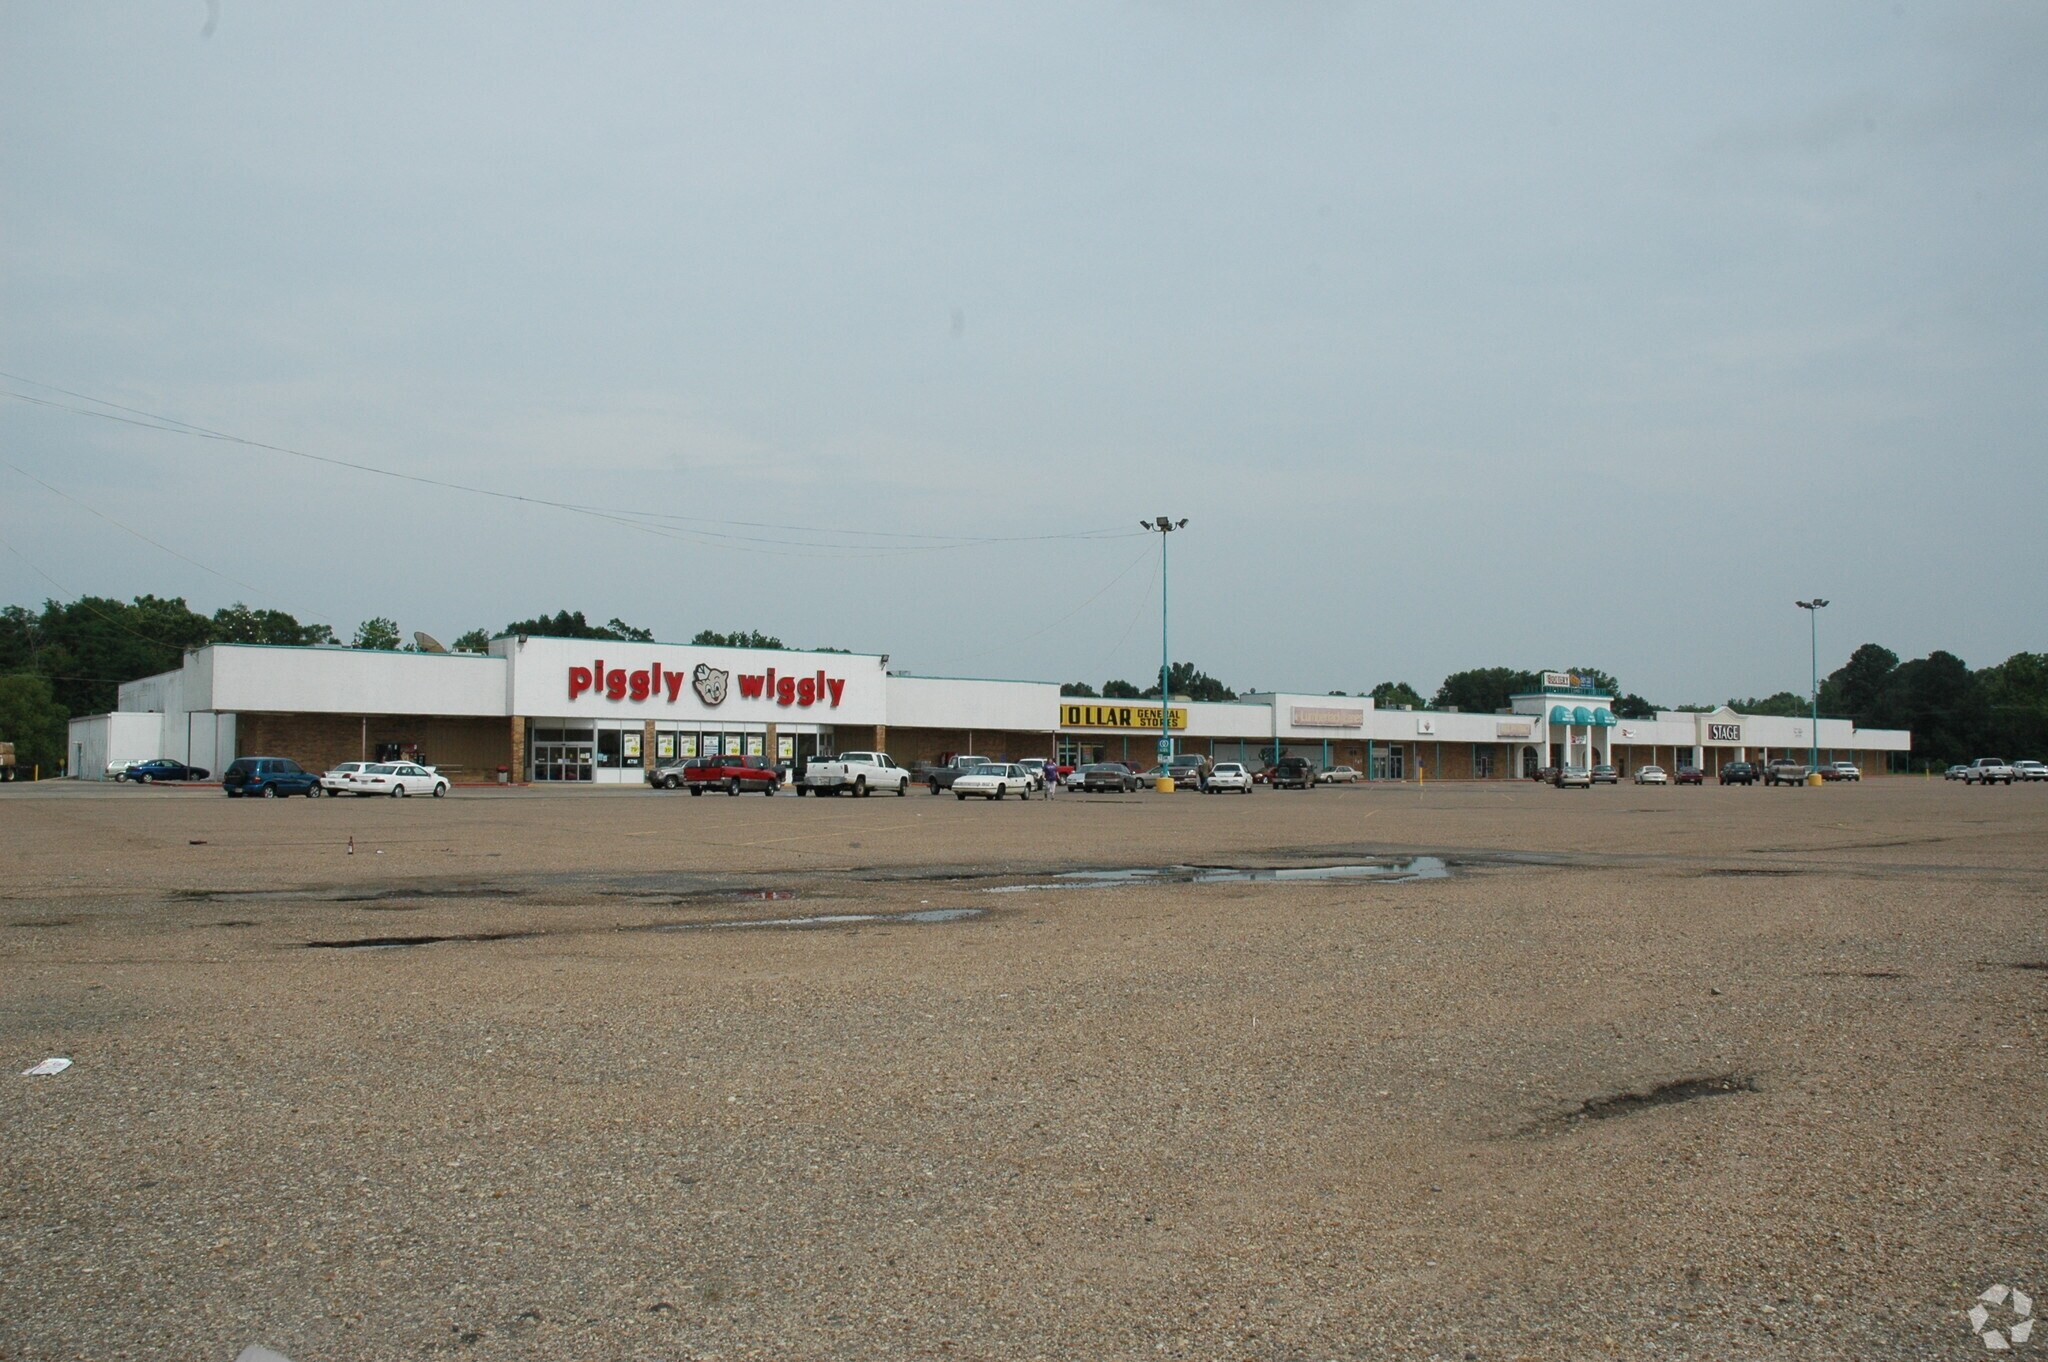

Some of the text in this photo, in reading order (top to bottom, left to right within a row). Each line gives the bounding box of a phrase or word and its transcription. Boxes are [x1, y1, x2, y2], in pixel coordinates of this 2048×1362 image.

[569, 660, 846, 707] piggly wiggly
[1137, 709, 1180, 719] GENEAL
[1712, 724, 1739, 740] STAGE
